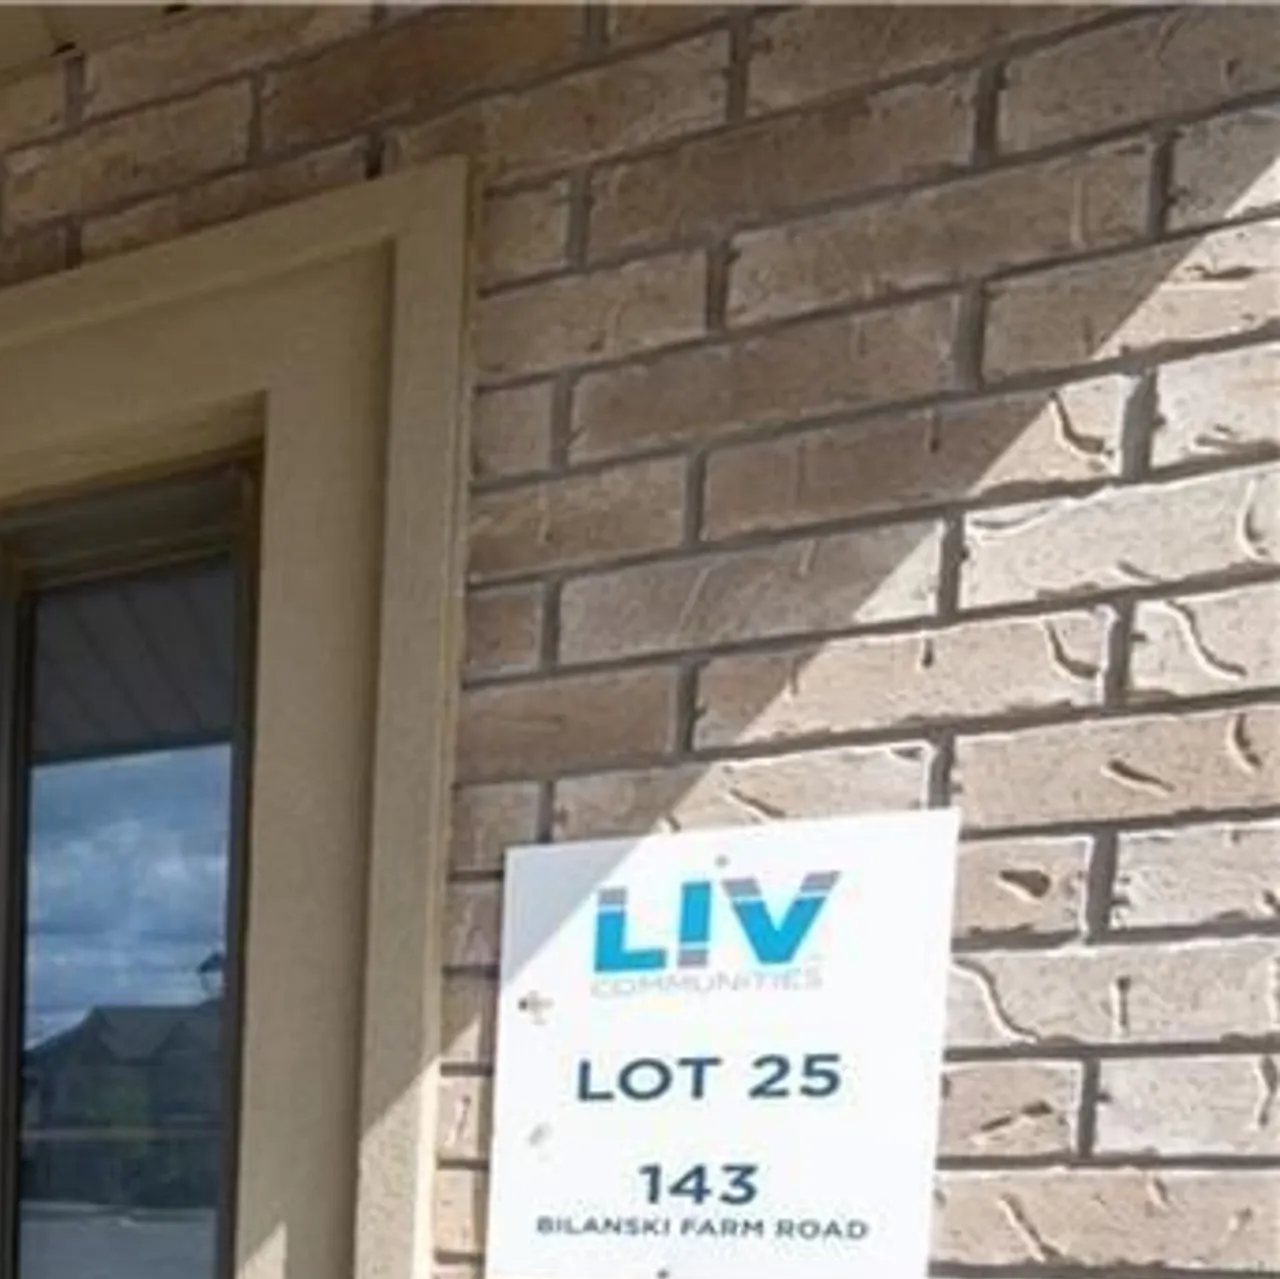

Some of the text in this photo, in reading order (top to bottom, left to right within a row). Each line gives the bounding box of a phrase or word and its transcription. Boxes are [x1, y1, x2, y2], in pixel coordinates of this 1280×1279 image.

[593, 869, 842, 973] LIV
[576, 1053, 841, 1102] LOT 25
[638, 1162, 760, 1206] 143
[536, 1214, 870, 1242] BILANSKI FARM ROAD
